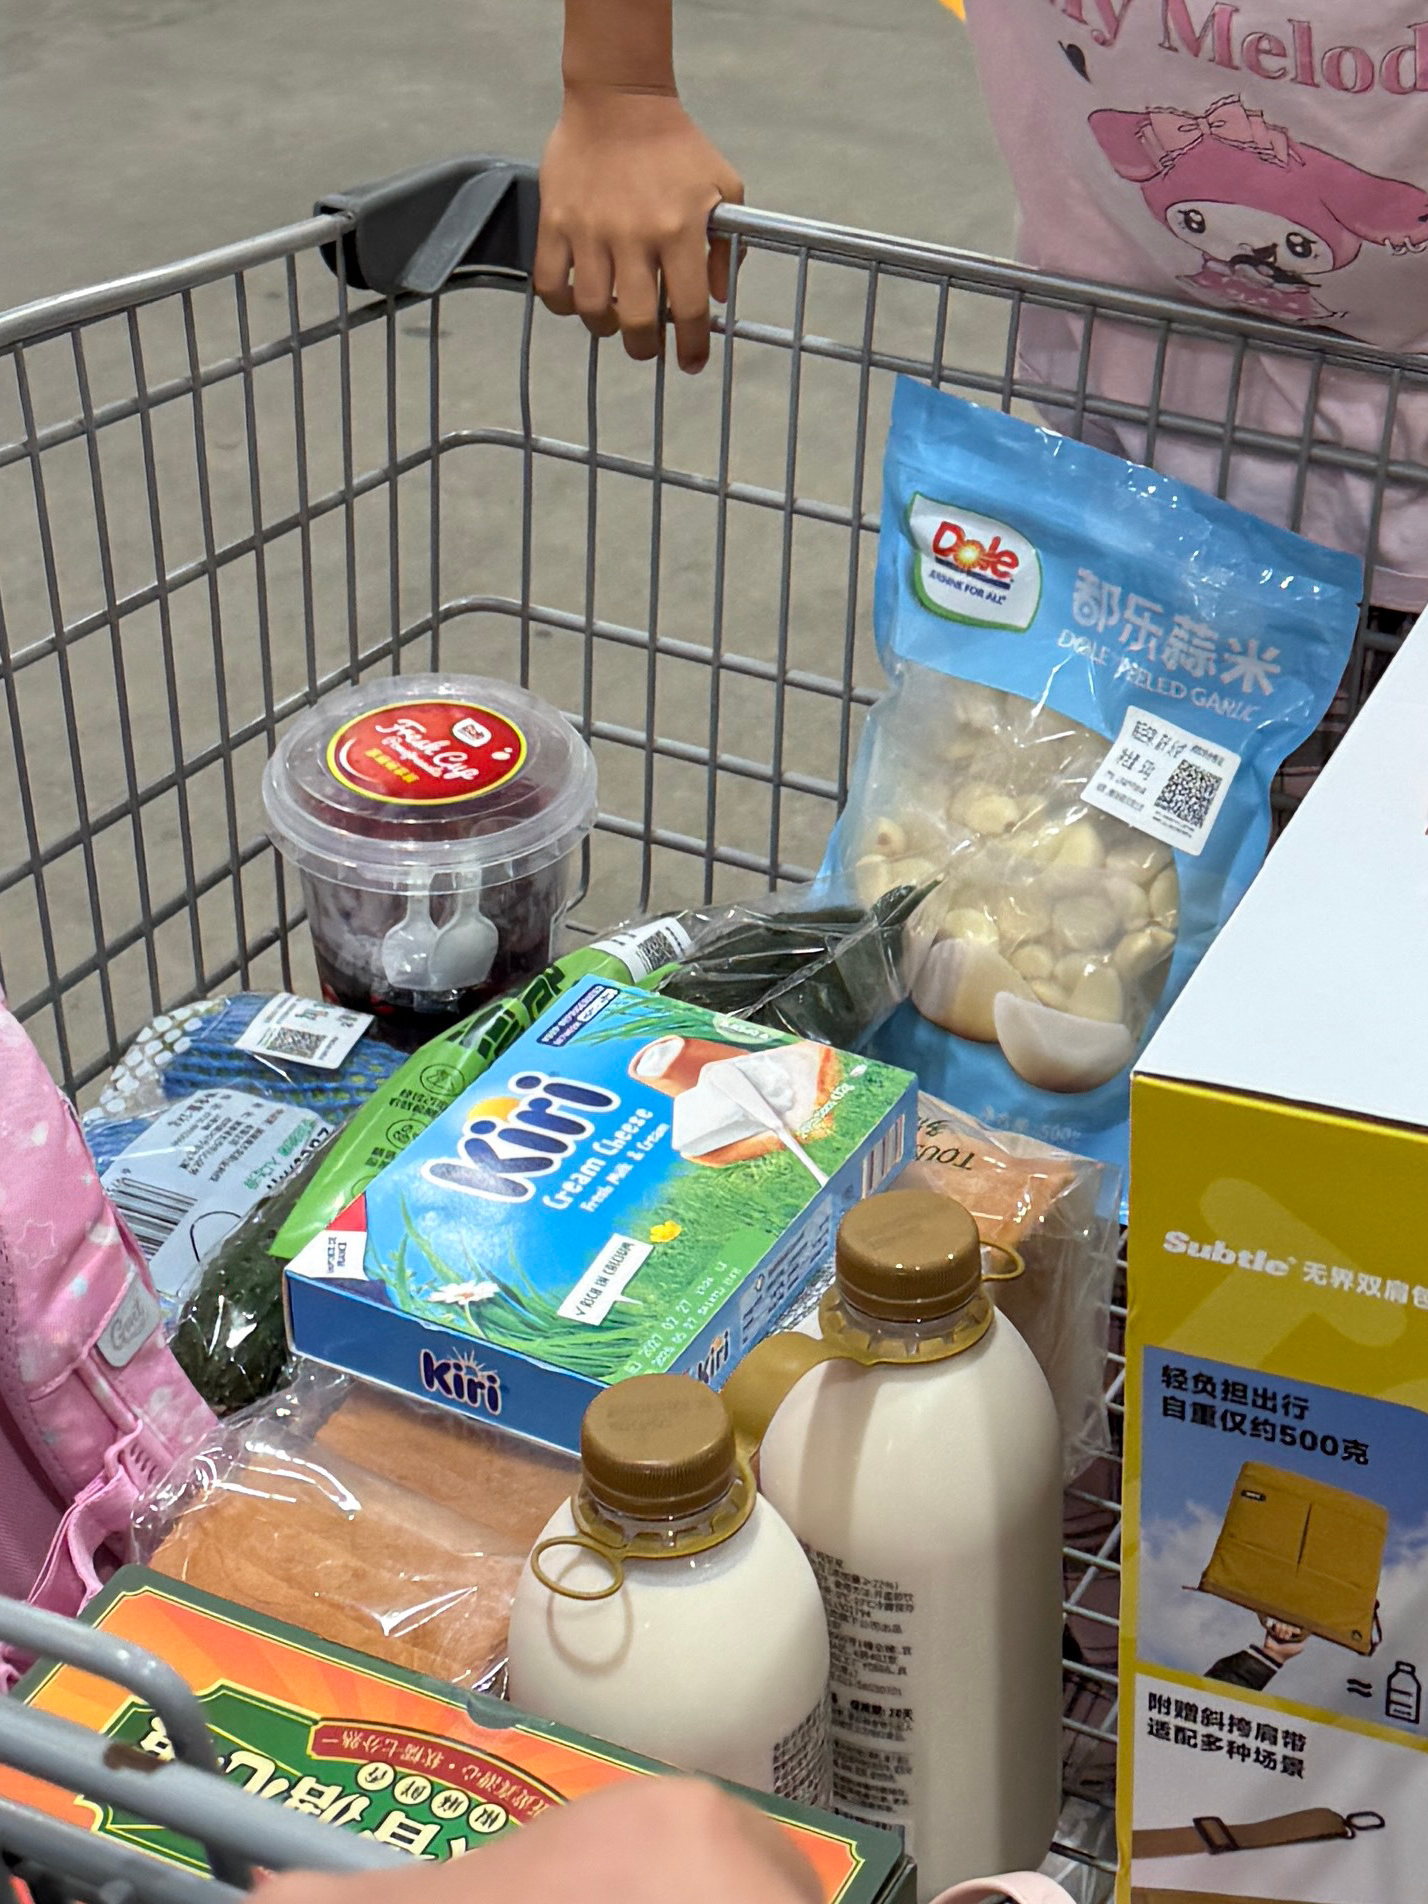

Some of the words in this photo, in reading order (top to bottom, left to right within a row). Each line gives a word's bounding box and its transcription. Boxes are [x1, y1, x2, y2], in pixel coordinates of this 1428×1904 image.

[933, 521, 1019, 578] Dole
[1071, 567, 1282, 697] 都乐蒜米
[1115, 657, 1187, 702] PEELED
[1190, 687, 1261, 724] GARLIC
[421, 1071, 621, 1204] Kiri
[543, 1155, 592, 1211] Cream
[593, 1106, 653, 1160] Cheese
[578, 1184, 612, 1214] Fresh
[1163, 1231, 1296, 1277] Subtle
[421, 1350, 502, 1415] Kiri
[1161, 1364, 1310, 1422] 轻负担出行
[1161, 1396, 1370, 1465] 自重仅约500克
[1147, 1693, 1306, 1753] 附赠斜挎肩带
[1147, 1719, 1305, 1780] 适配多种场景
